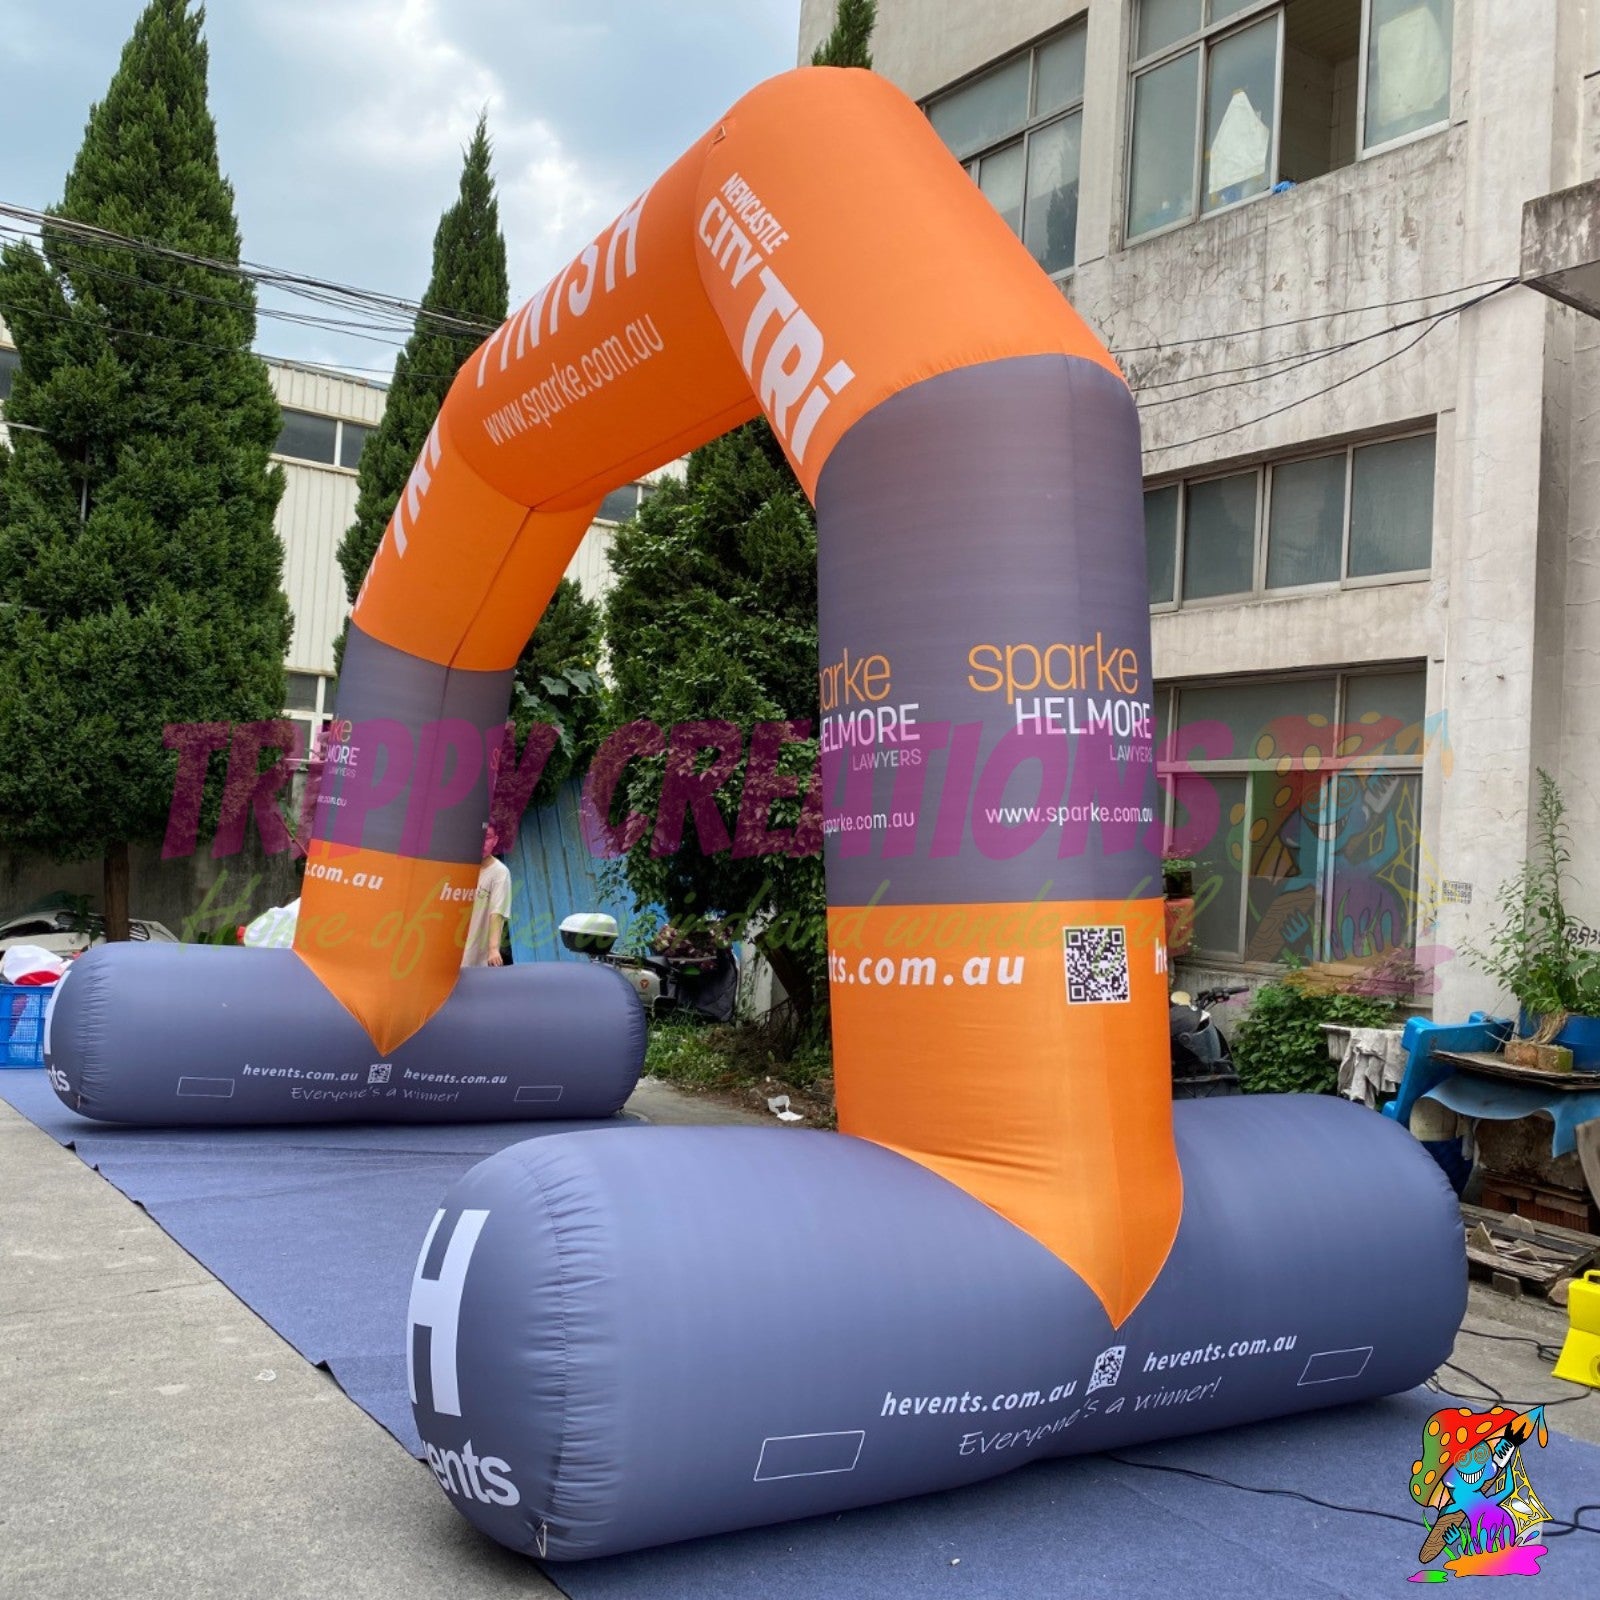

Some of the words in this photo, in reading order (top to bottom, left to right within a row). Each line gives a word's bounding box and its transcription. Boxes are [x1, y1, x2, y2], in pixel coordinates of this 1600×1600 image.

[698, 196, 763, 289] CITY
[720, 172, 790, 255] NEWCASTLE
[482, 313, 664, 446] www.sparke.com.au
[968, 631, 1138, 704] sparke
[1015, 697, 1152, 739] HELMORE
[852, 748, 922, 771] LAWYERS
[242, 1063, 359, 1081] hevents.com.au
[403, 1068, 508, 1084] hevents.com.au
[290, 1086, 381, 1102] Everyone's
[385, 1085, 397, 1097] a
[402, 1088, 460, 1103] winner!
[880, 1380, 1078, 1417] hevents.com.au
[1143, 1333, 1298, 1373] hevents.com.au
[958, 1399, 1100, 1456] Everyone's
[1105, 1398, 1123, 1414] a
[1134, 1376, 1223, 1412] winner!
